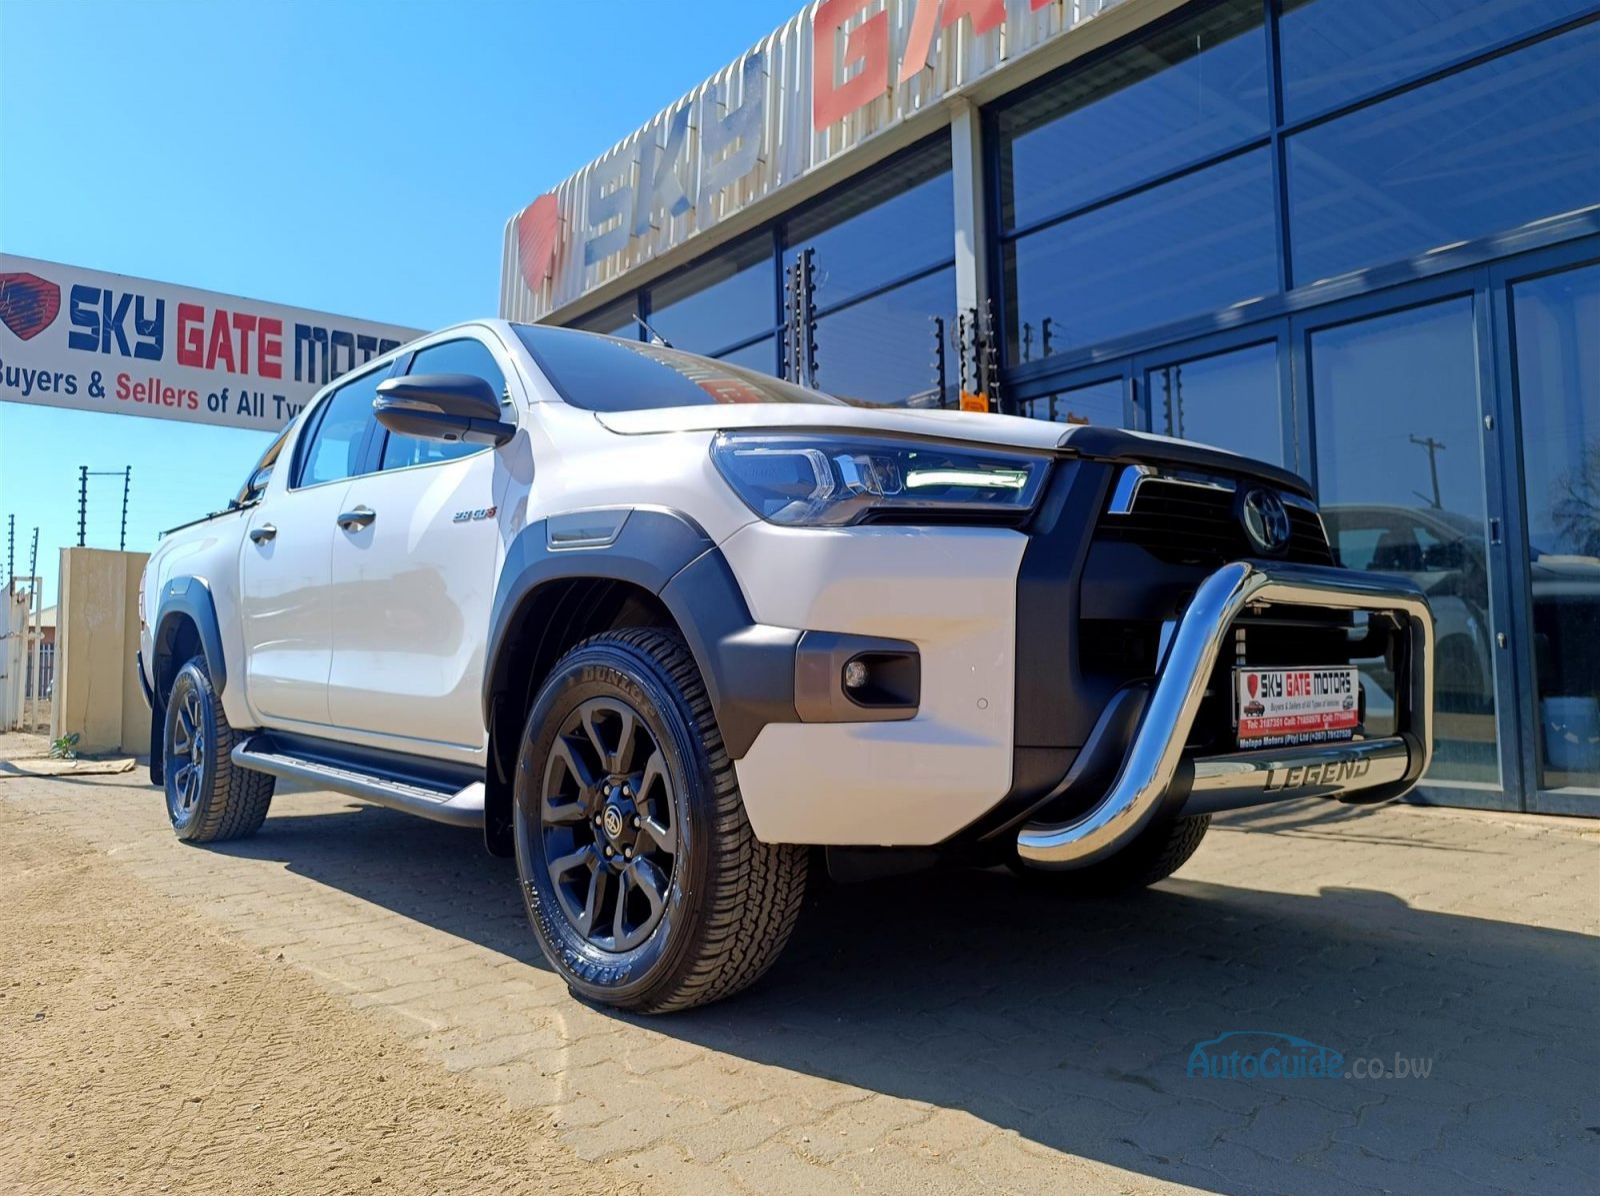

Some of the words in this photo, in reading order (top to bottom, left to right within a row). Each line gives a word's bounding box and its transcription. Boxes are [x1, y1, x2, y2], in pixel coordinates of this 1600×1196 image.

[584, 52, 764, 267] SKY
[68, 283, 166, 361] SKY
[176, 302, 283, 380] GATE
[88, 373, 106, 399] &
[116, 372, 200, 411] Sellers
[207, 387, 230, 413] of
[236, 391, 265, 418] All
[272, 395, 305, 421] Ty
[1261, 673, 1283, 698] SKY
[1285, 672, 1311, 697] GATE
[1313, 671, 1351, 695] MOTORS
[1264, 757, 1371, 792] LEGEND
